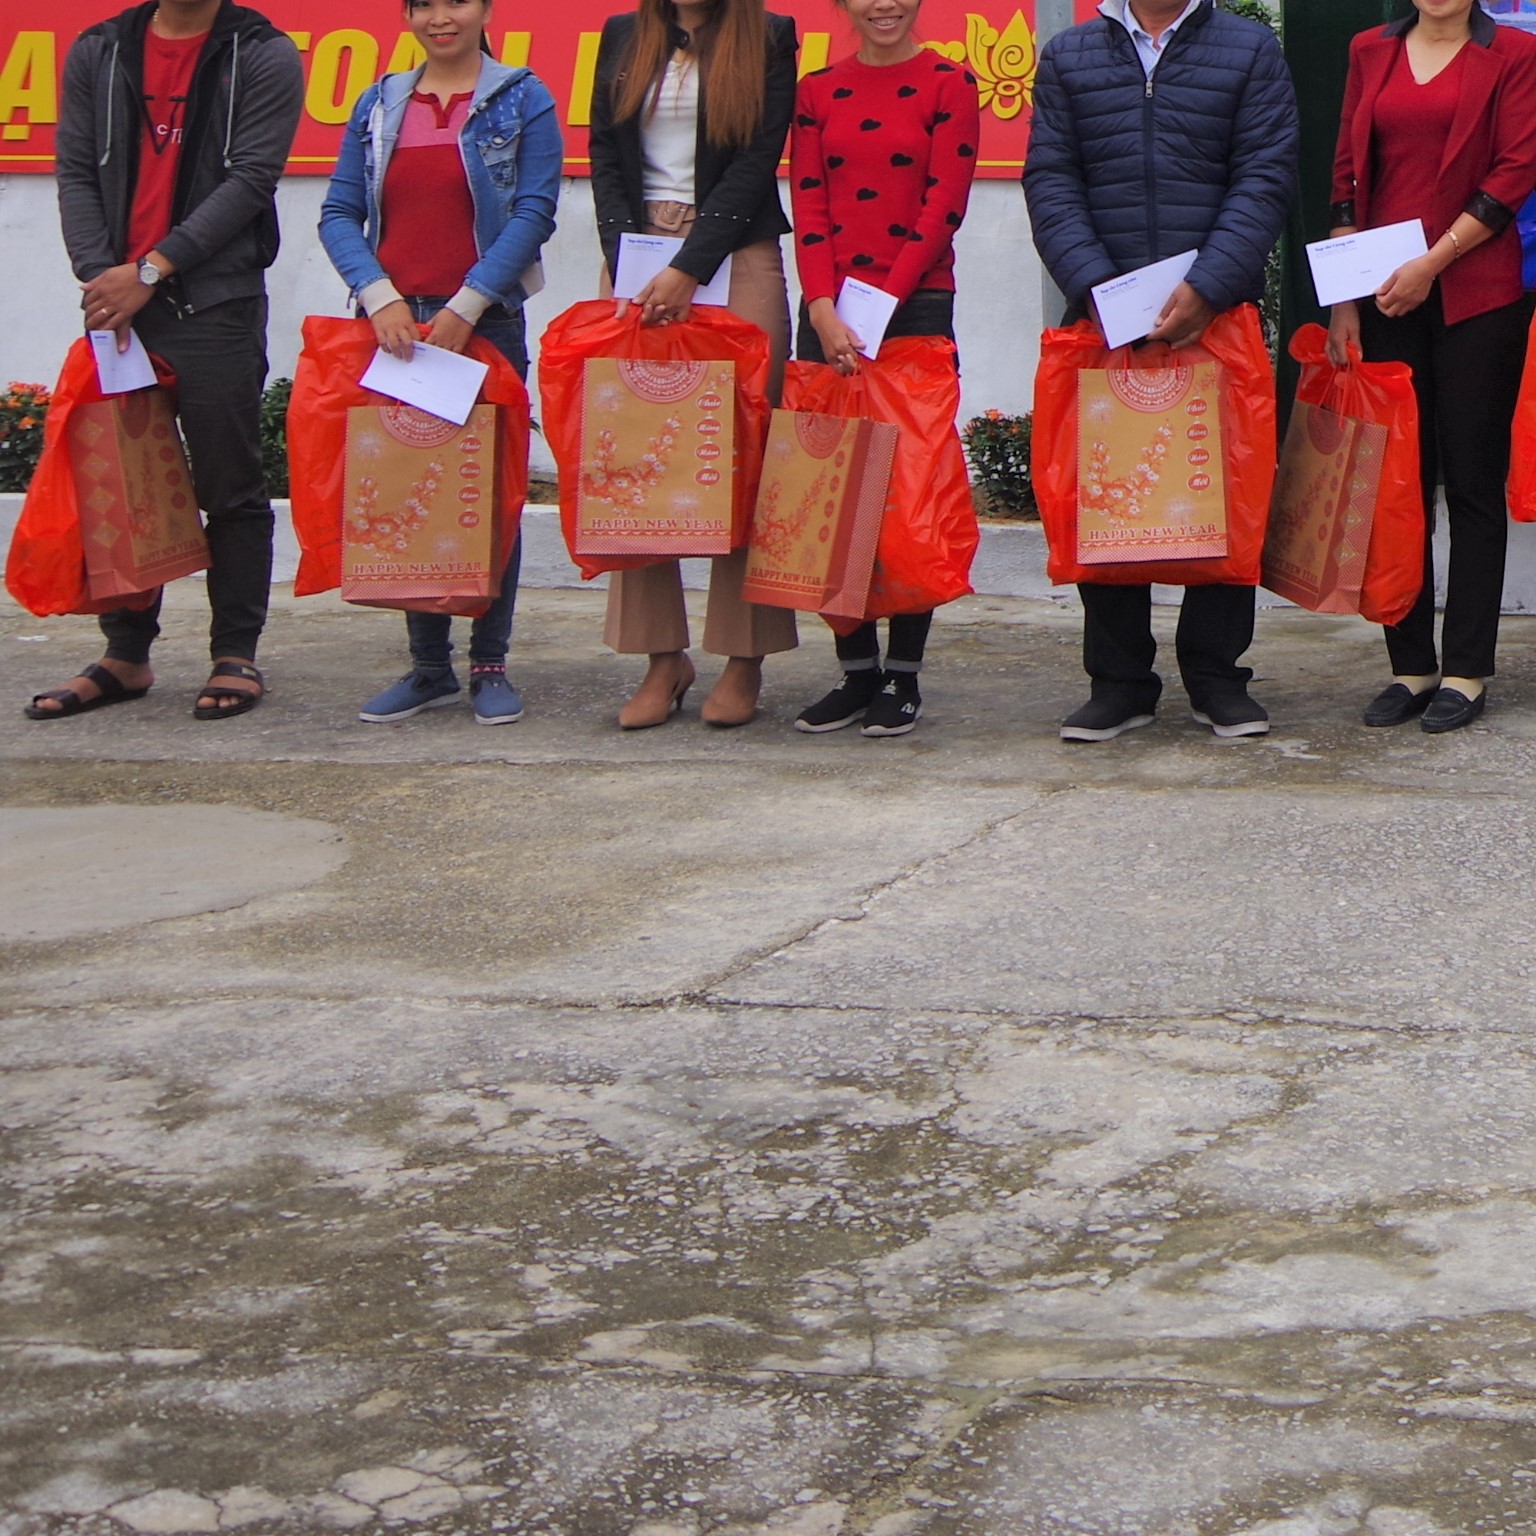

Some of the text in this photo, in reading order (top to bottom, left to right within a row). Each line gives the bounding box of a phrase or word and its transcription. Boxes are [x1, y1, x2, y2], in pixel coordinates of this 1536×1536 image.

[591, 518, 724, 530] HAPPY NEW YEAR
[1089, 523, 1218, 540] HAPPY NEW YEAR
[354, 561, 481, 574] HAPPY NEW YEAR
